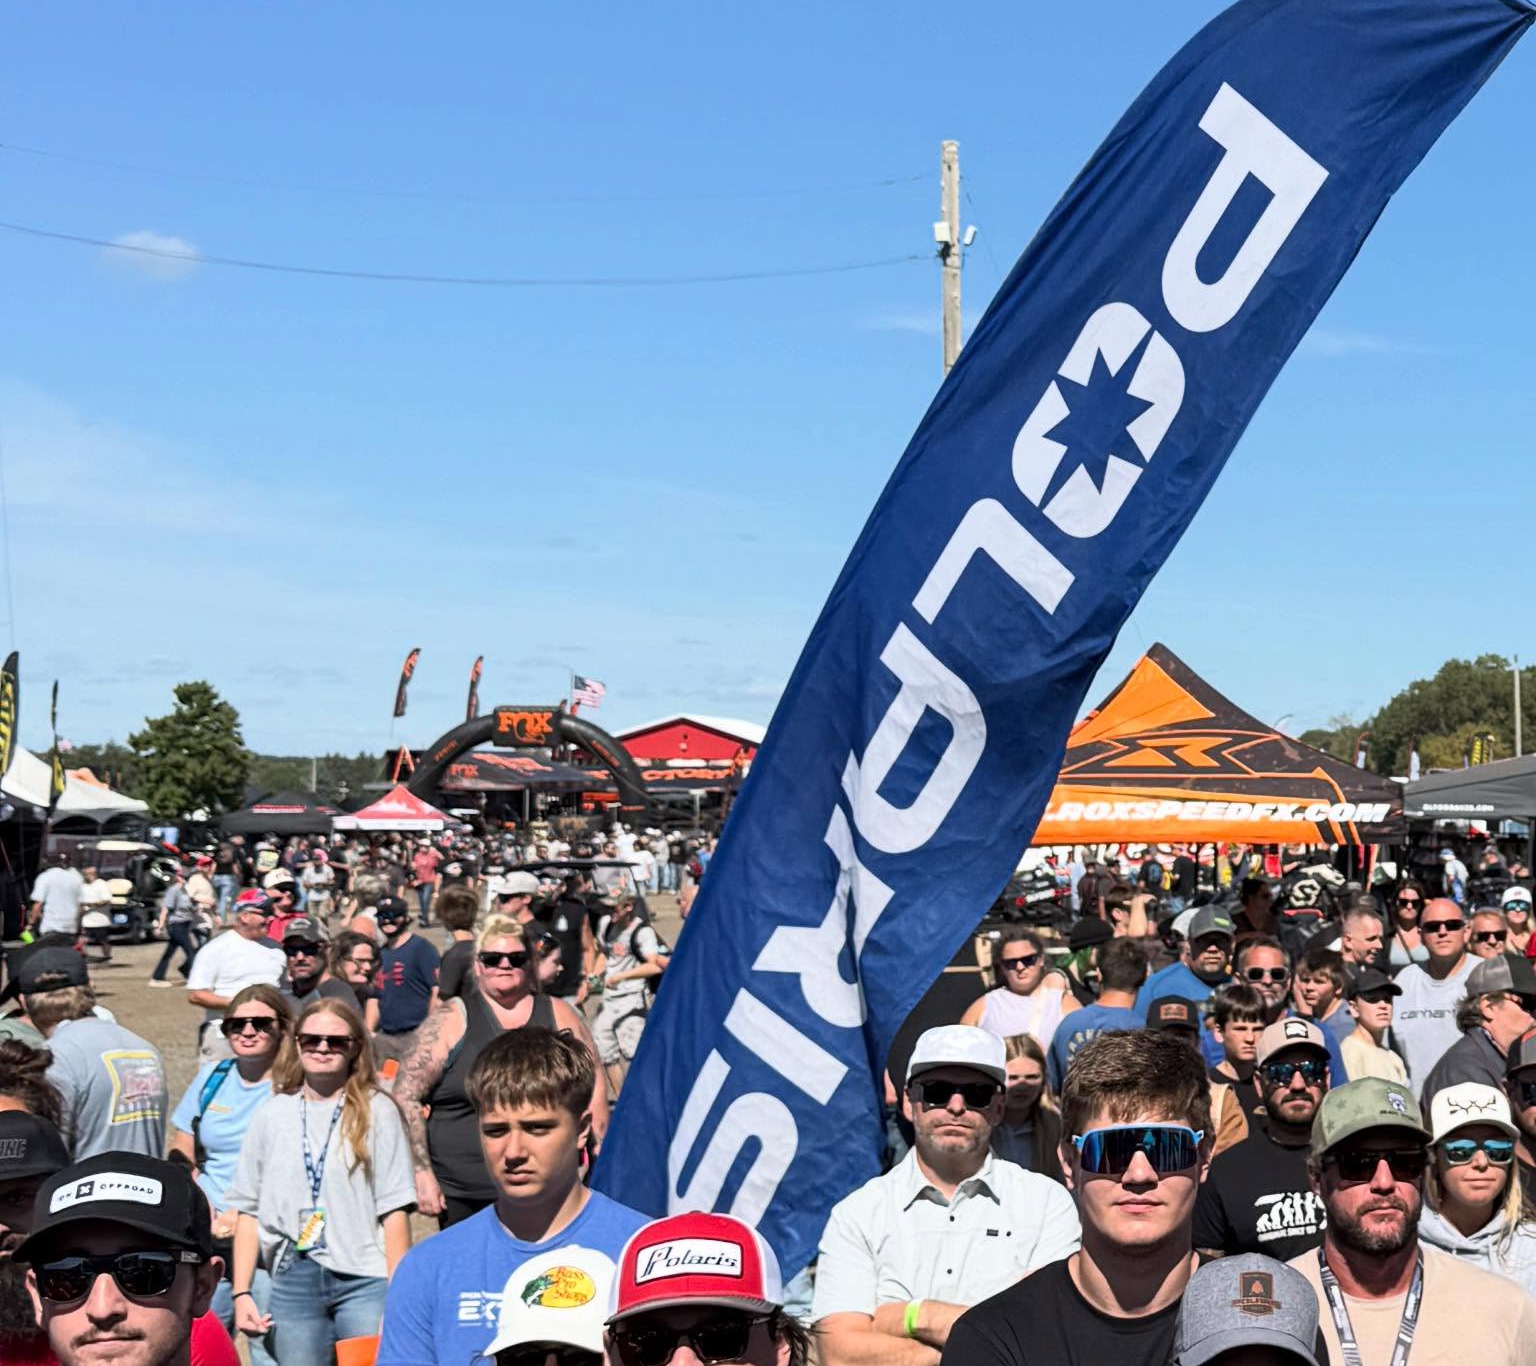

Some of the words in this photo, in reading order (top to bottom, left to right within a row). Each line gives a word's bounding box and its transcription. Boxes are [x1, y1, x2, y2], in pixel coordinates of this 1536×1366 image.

[667, 82, 1329, 1227] POLARIS
[498, 711, 553, 745] FOX
[100, 1184, 153, 1194] OFFROAD
[640, 1246, 738, 1278] Polaris
[556, 1266, 585, 1281] Bass
[555, 1278, 577, 1288] Pro
[553, 1290, 588, 1304] Shops
[458, 1299, 502, 1321] EX
